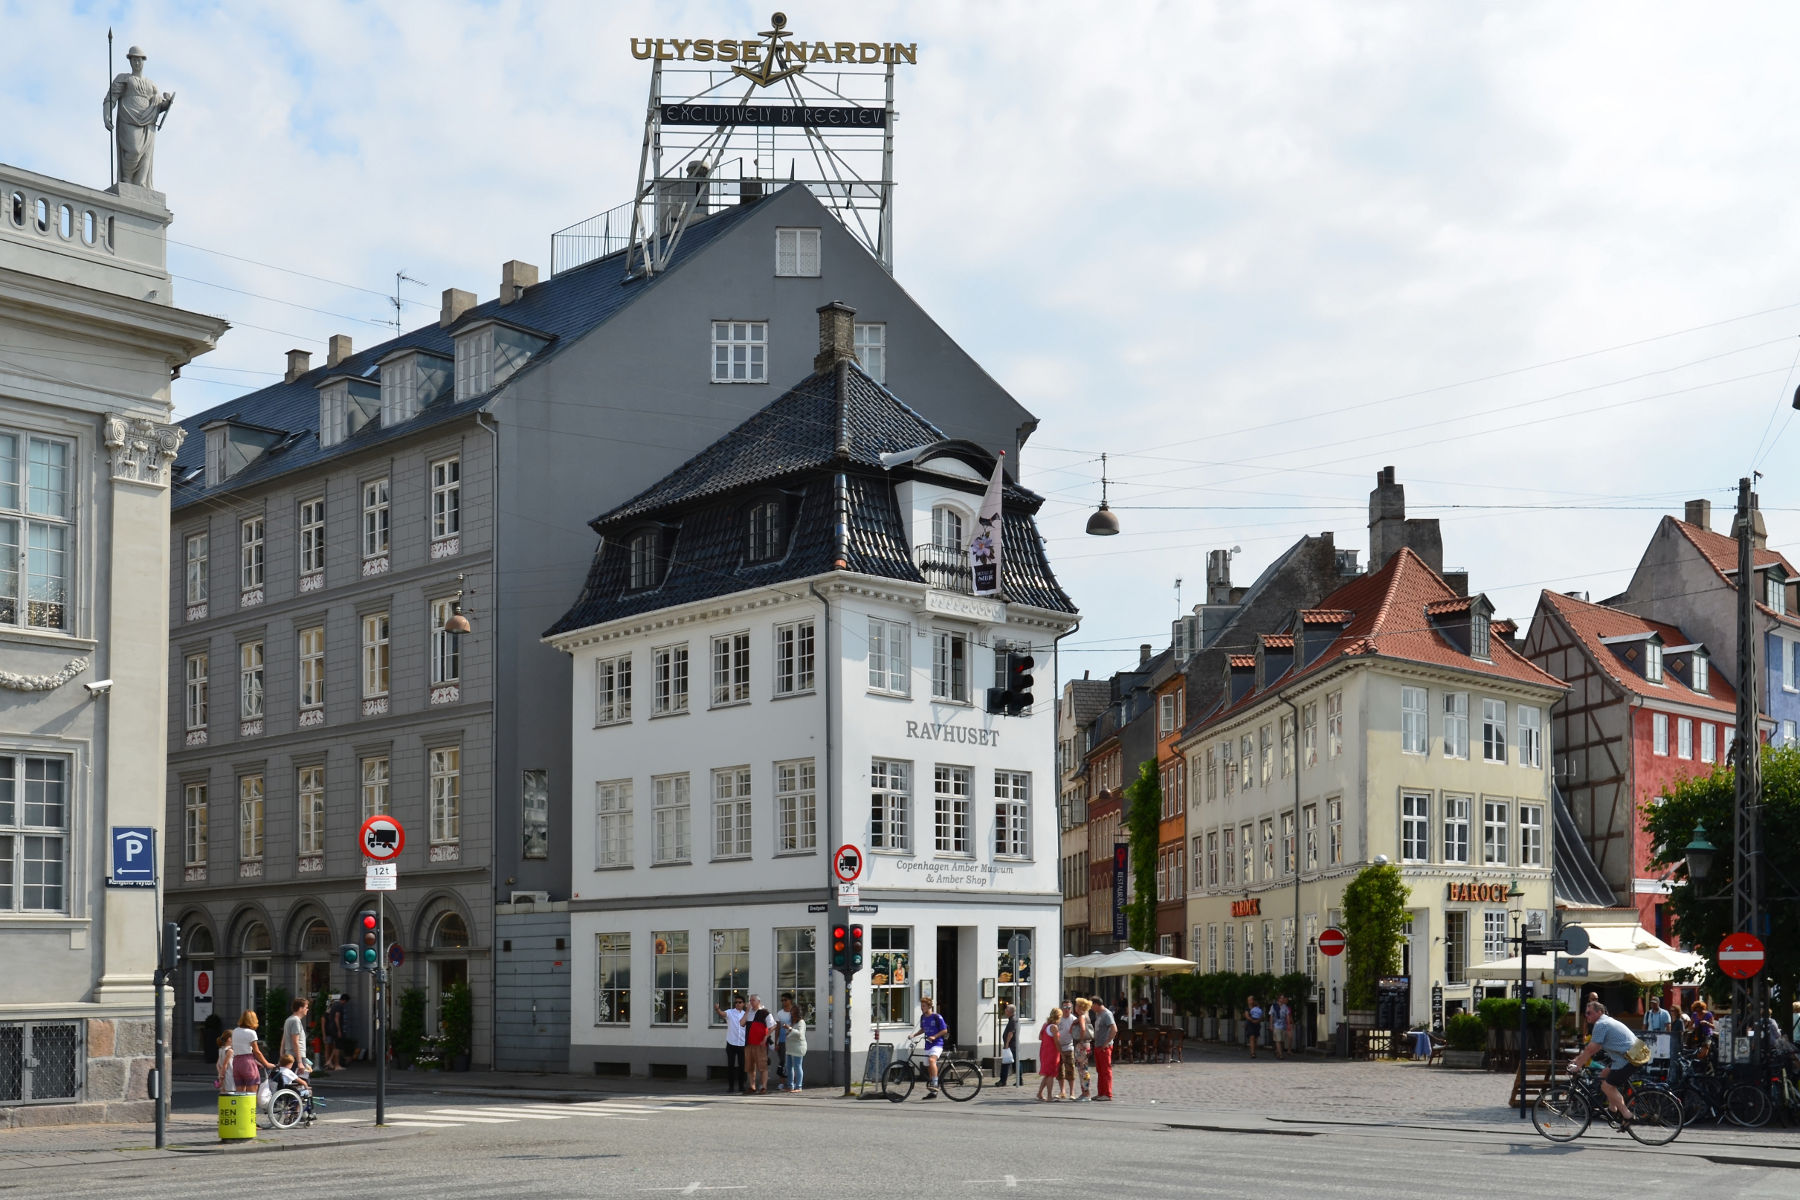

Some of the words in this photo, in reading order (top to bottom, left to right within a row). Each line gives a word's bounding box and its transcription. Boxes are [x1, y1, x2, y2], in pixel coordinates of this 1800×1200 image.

[630, 38, 761, 62] ULYSSE
[784, 41, 917, 65] NARDIN
[666, 106, 771, 122] EXCLUSIVELY
[781, 108, 796, 122] BY
[804, 108, 880, 124] REESLEV
[906, 720, 1000, 747] RAVHUSET
[126, 840, 143, 862] P
[896, 860, 949, 873] Copenhagen
[951, 862, 978, 872] Amber
[980, 863, 1014, 874] Museum
[926, 873, 935, 883] &
[936, 874, 964, 884] Amber
[966, 875, 987, 887] Shop
[1449, 882, 1510, 902] BAROCK
